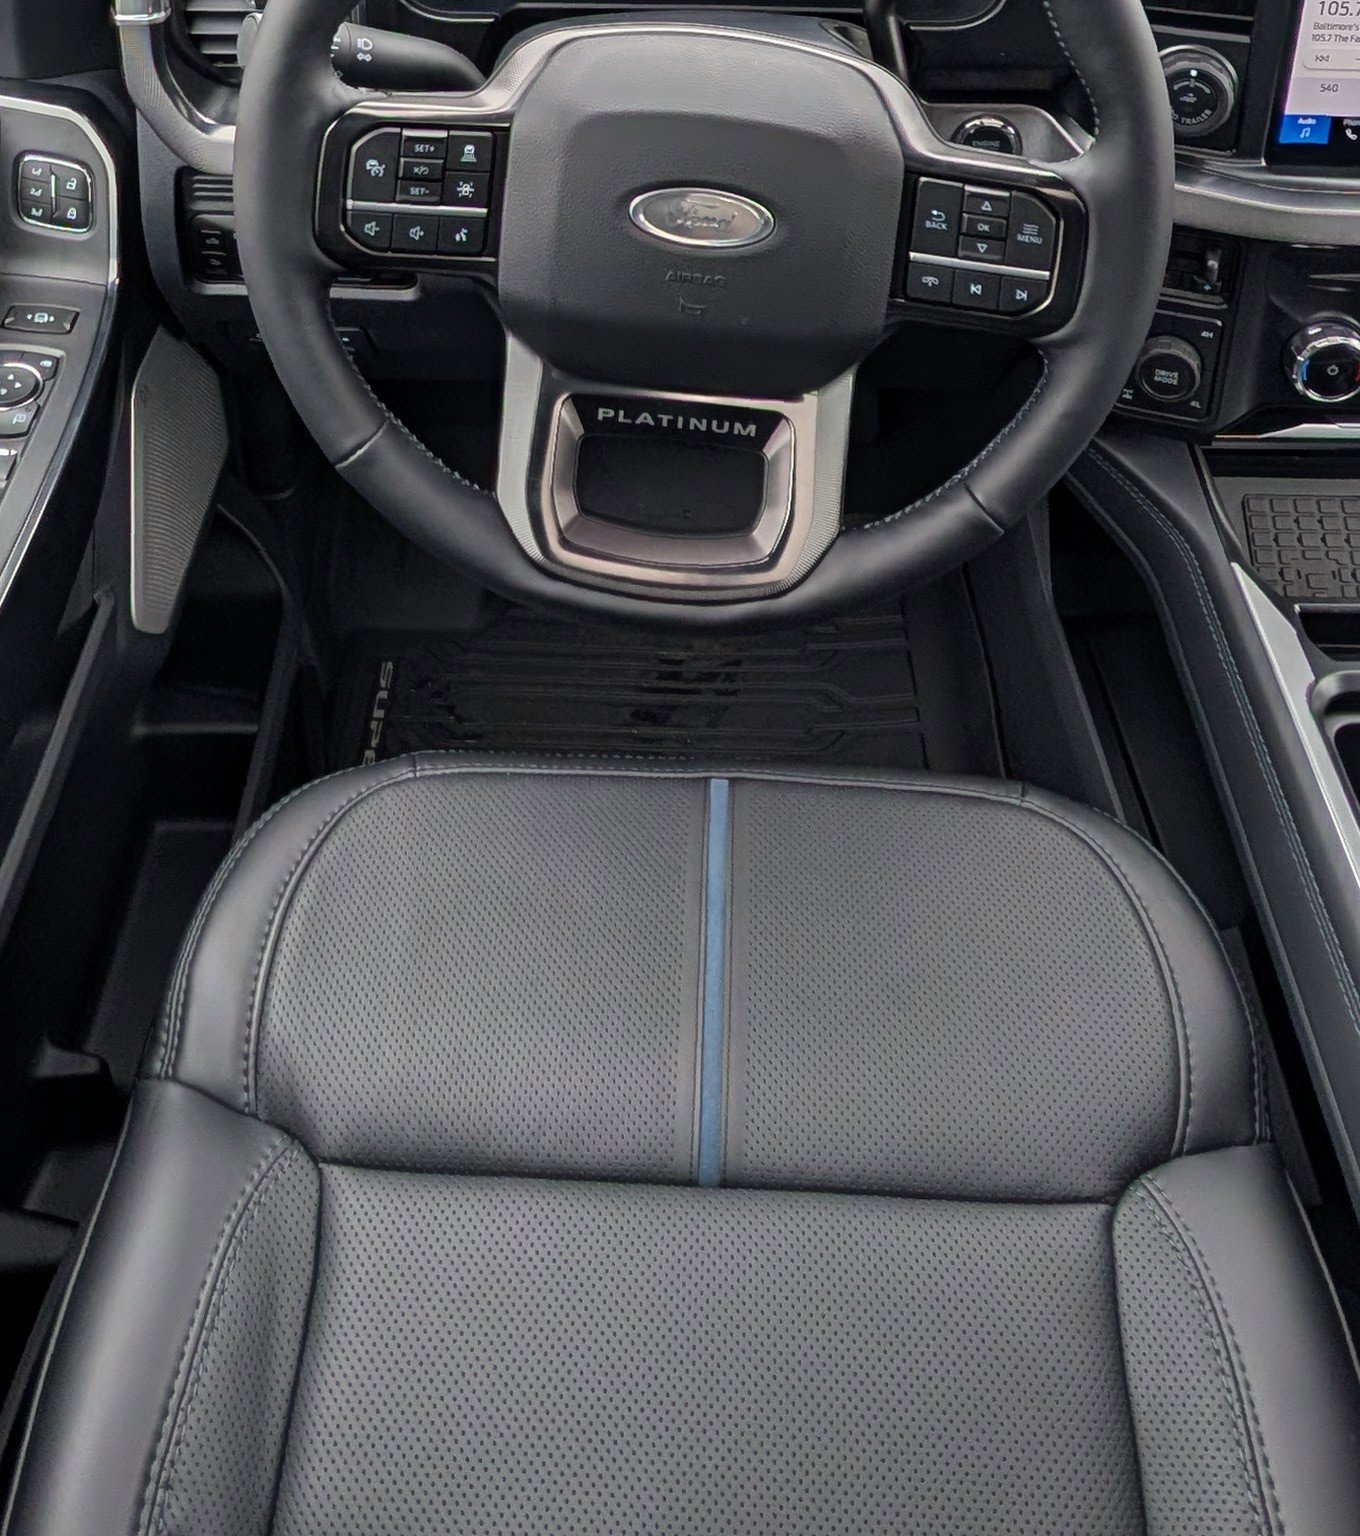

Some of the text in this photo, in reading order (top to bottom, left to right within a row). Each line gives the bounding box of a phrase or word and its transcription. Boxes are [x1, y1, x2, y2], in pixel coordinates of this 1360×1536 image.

[1313, 21, 1360, 32] Baltimore's
[1311, 33, 1332, 43] 105.7
[1333, 33, 1349, 43] The
[1319, 83, 1339, 93] 540
[1181, 109, 1213, 124] TRAILER
[1297, 117, 1317, 126] Audio
[925, 220, 948, 231] BACK
[977, 223, 990, 232] OK
[1016, 233, 1043, 244] MENU
[665, 270, 728, 289] AIRBAG
[1154, 368, 1179, 378] DRIVE
[1153, 376, 1179, 385] MODE
[597, 407, 757, 438] PLATINUM
